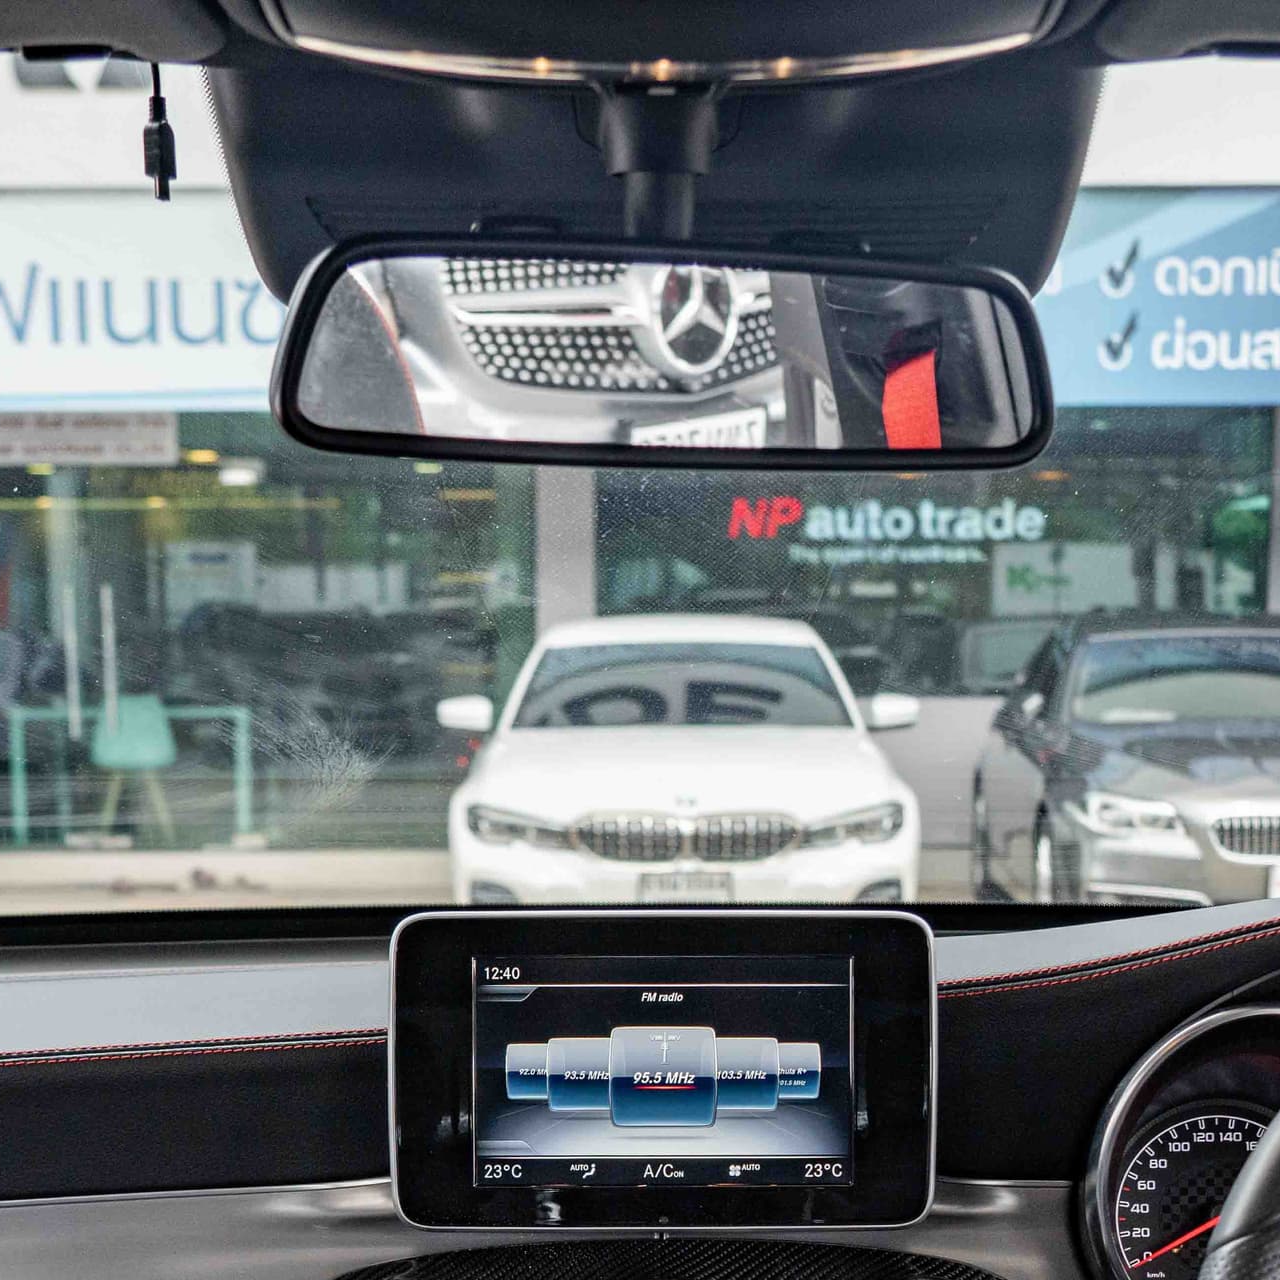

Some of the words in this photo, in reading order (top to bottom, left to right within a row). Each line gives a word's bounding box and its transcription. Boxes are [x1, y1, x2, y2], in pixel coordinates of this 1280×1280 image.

[727, 496, 803, 539] NP
[805, 500, 915, 541] auto
[919, 498, 1046, 541] trade
[484, 967, 520, 980] 12:40
[641, 992, 657, 1003] FM
[658, 992, 684, 1003] radio
[519, 1068, 536, 1077] 92.0
[564, 1071, 586, 1080] 93.5
[588, 1071, 610, 1080] MHz
[633, 1072, 662, 1084] 95.5
[665, 1072, 696, 1084] MHz
[717, 1070, 744, 1080] 103.5
[745, 1070, 767, 1080] MHz
[1192, 1132, 1215, 1143] 120
[1219, 1132, 1243, 1143] 140
[1168, 1142, 1191, 1152] 100
[1245, 1141, 1260, 1152] 16
[570, 1164, 589, 1172] AUTO
[741, 1164, 761, 1172] AUTO
[1149, 1159, 1168, 1169] 80
[484, 1164, 522, 1179] 23°C
[804, 1164, 843, 1178] 23°C
[1137, 1180, 1156, 1191] 60
[1130, 1203, 1150, 1214] 40
[1131, 1228, 1151, 1238] 20
[1146, 1271, 1166, 1279] km/h
